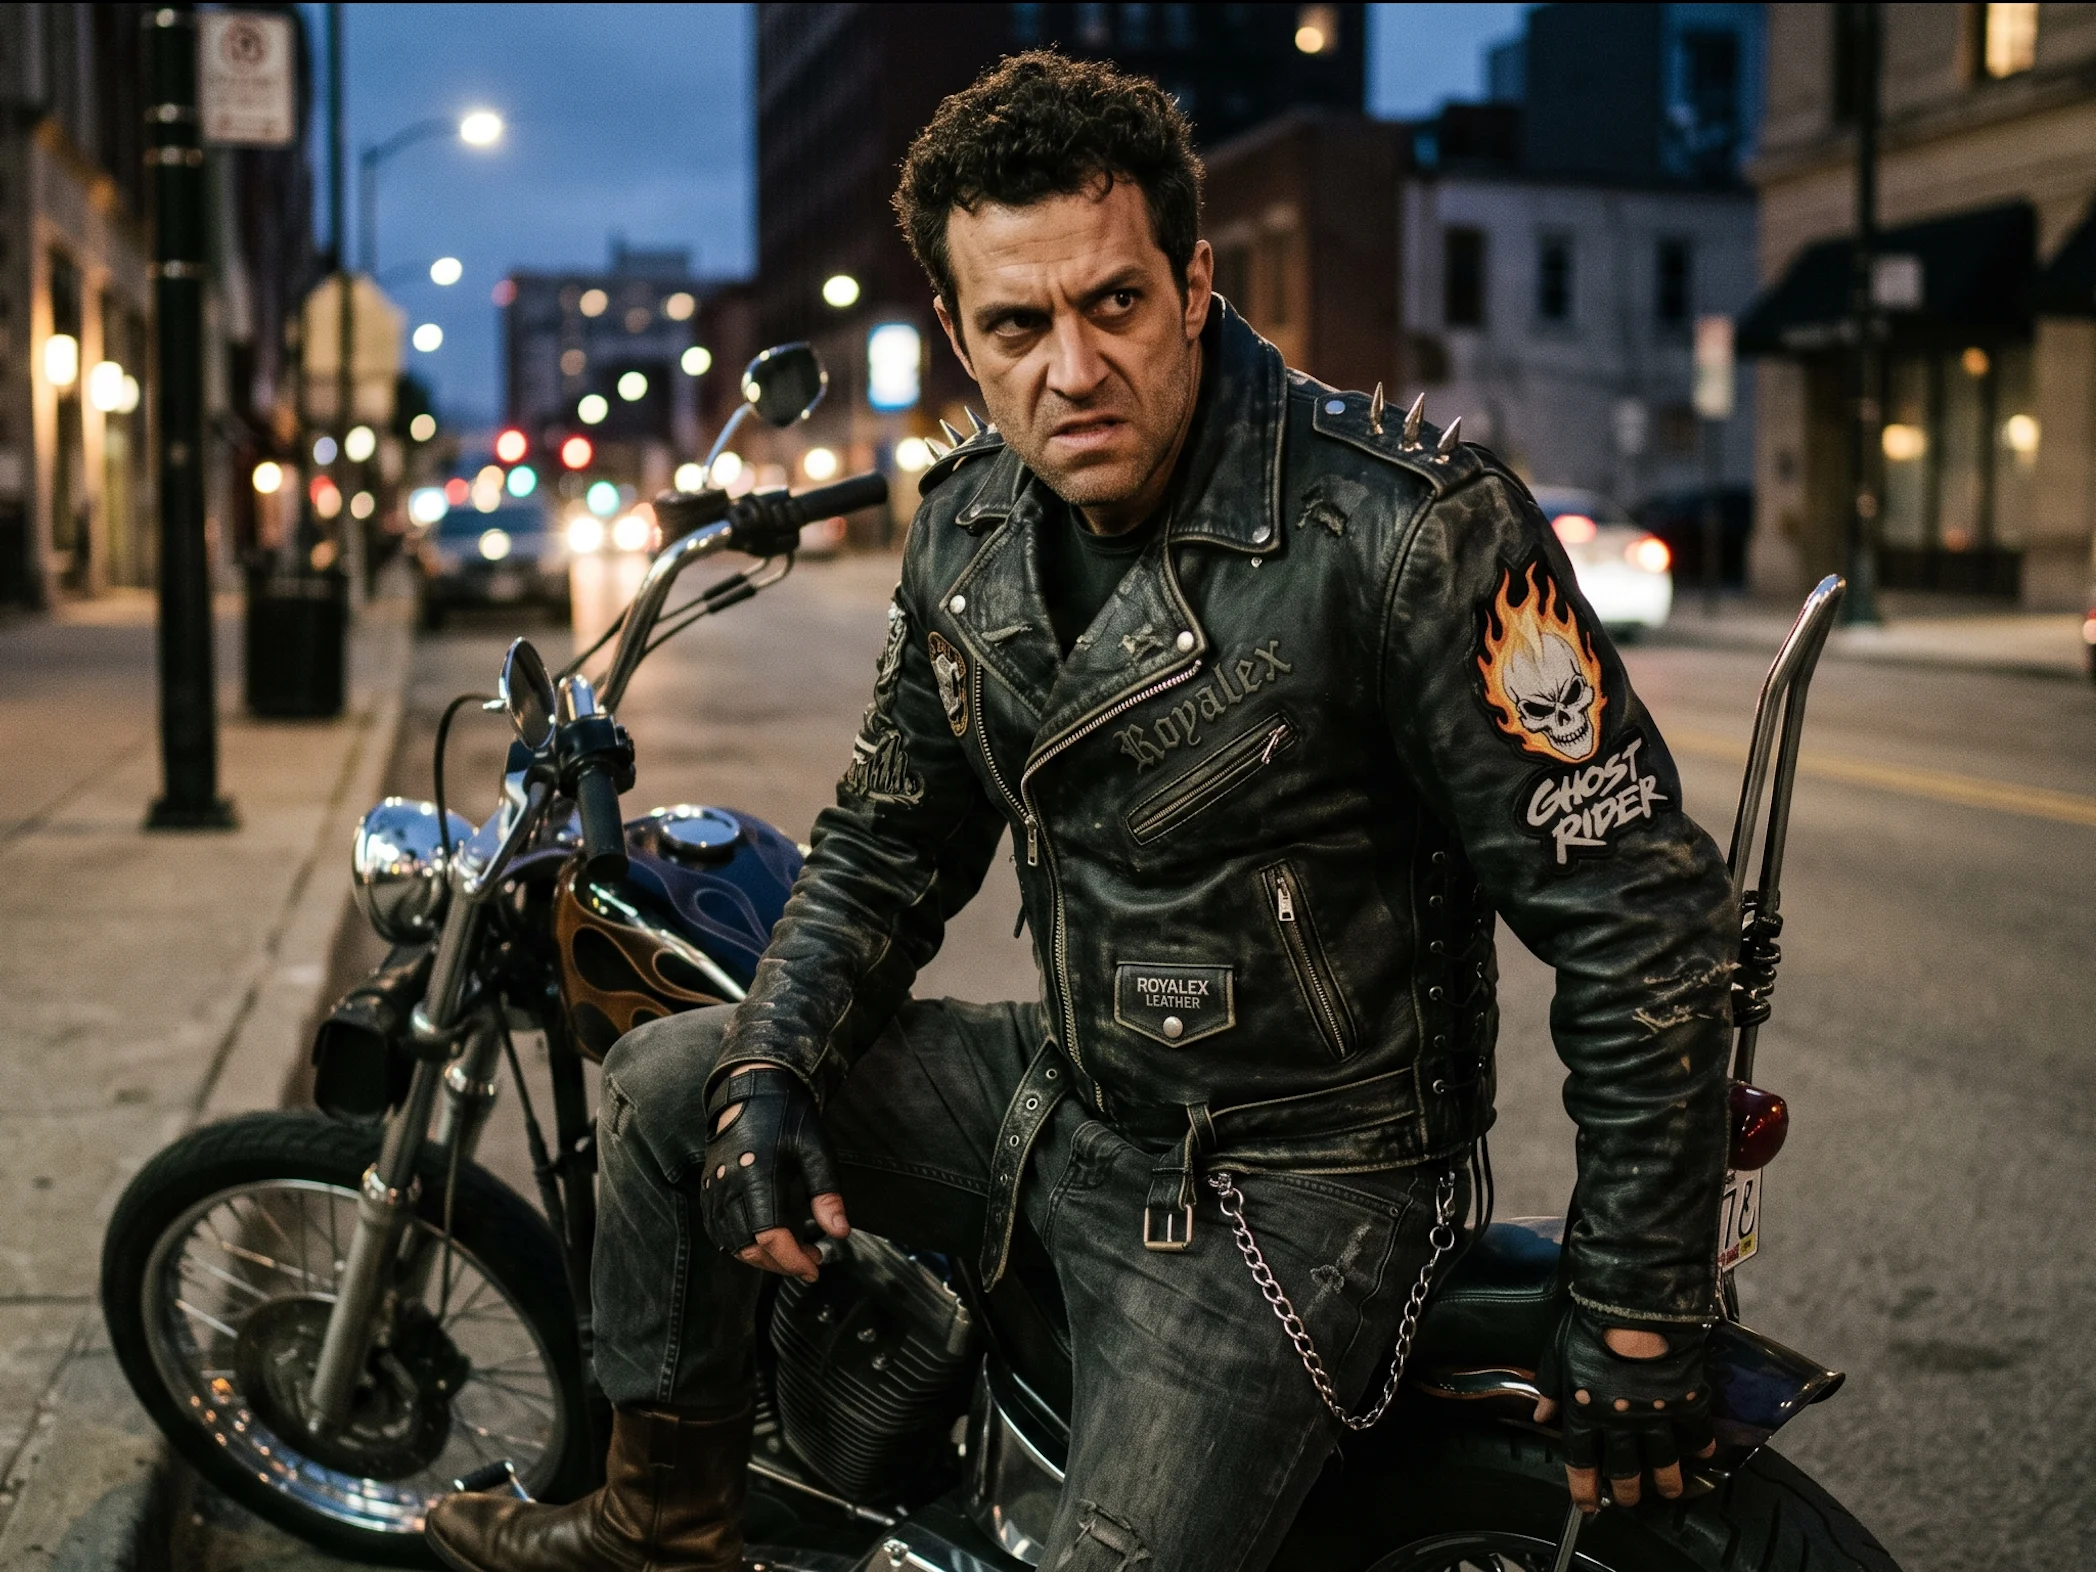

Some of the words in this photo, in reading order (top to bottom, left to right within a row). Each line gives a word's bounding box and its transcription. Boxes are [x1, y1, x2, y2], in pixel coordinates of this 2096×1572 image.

[1112, 640, 1292, 773] Royalex
[1527, 737, 1642, 827] GHOST
[1551, 775, 1669, 866] RIDER
[1137, 977, 1209, 996] ROYALEX
[1146, 994, 1201, 1009] LEATHER
